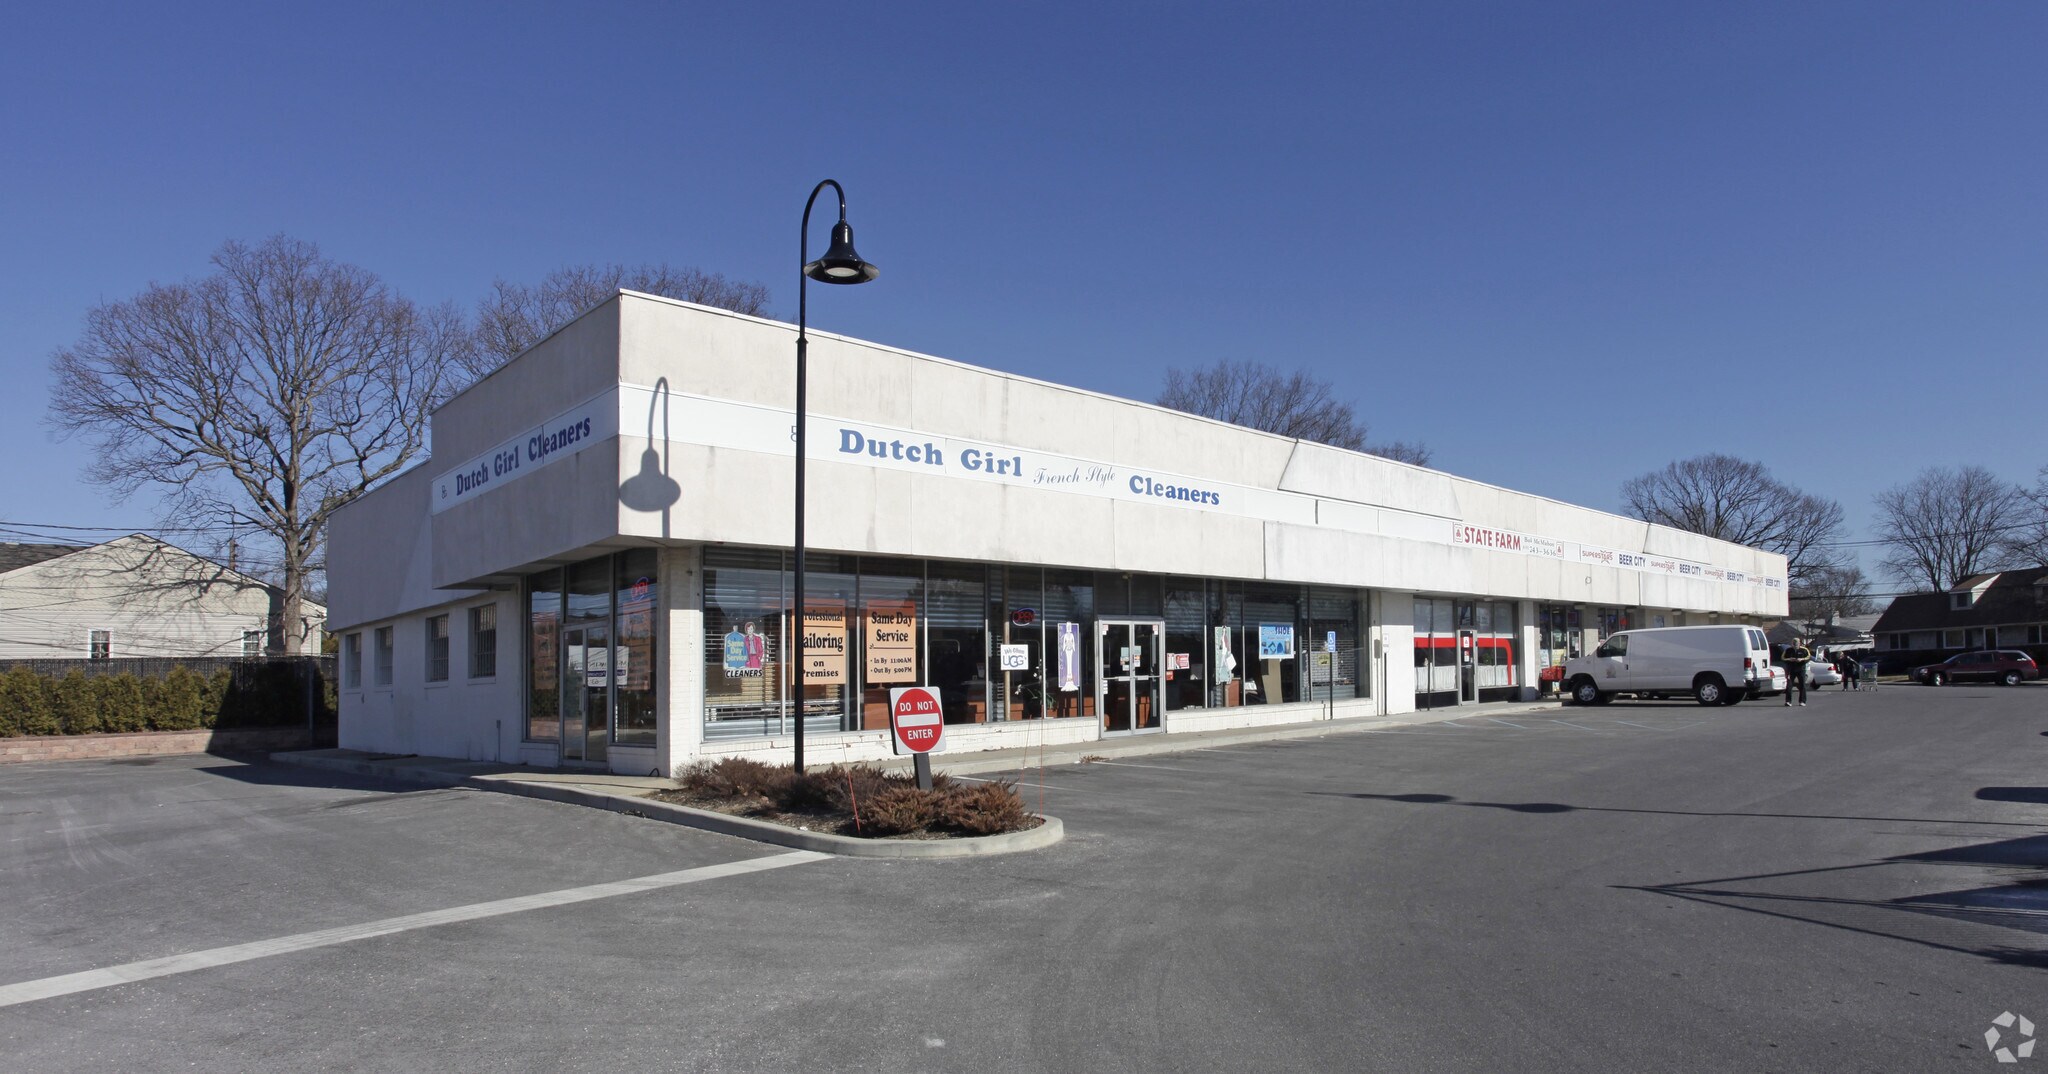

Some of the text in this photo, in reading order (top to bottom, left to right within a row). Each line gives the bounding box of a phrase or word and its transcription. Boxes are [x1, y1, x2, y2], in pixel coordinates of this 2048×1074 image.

[456, 417, 591, 496] Dutch Girl Cleaners
[839, 429, 1220, 506] Dutch Girl French Style Cleaners
[1464, 526, 1521, 551] STATE FARM
[1619, 553, 1633, 566] BEER
[1634, 555, 1646, 567] CITY
[1679, 563, 1691, 575] BEER
[1691, 565, 1702, 577] CITY
[1727, 571, 1736, 582] BEER
[1736, 573, 1745, 583] CITY
[804, 610, 843, 622] rofessional
[871, 611, 914, 627] Same Day
[876, 629, 909, 642] Service
[727, 640, 745, 648] Same
[803, 632, 844, 653] ailoring
[730, 646, 743, 655] Day
[880, 657, 888, 665] By
[726, 669, 763, 678] CLEANERS
[884, 667, 891, 675] By
[899, 701, 934, 712] DO NOT
[907, 728, 934, 740] ENTER
